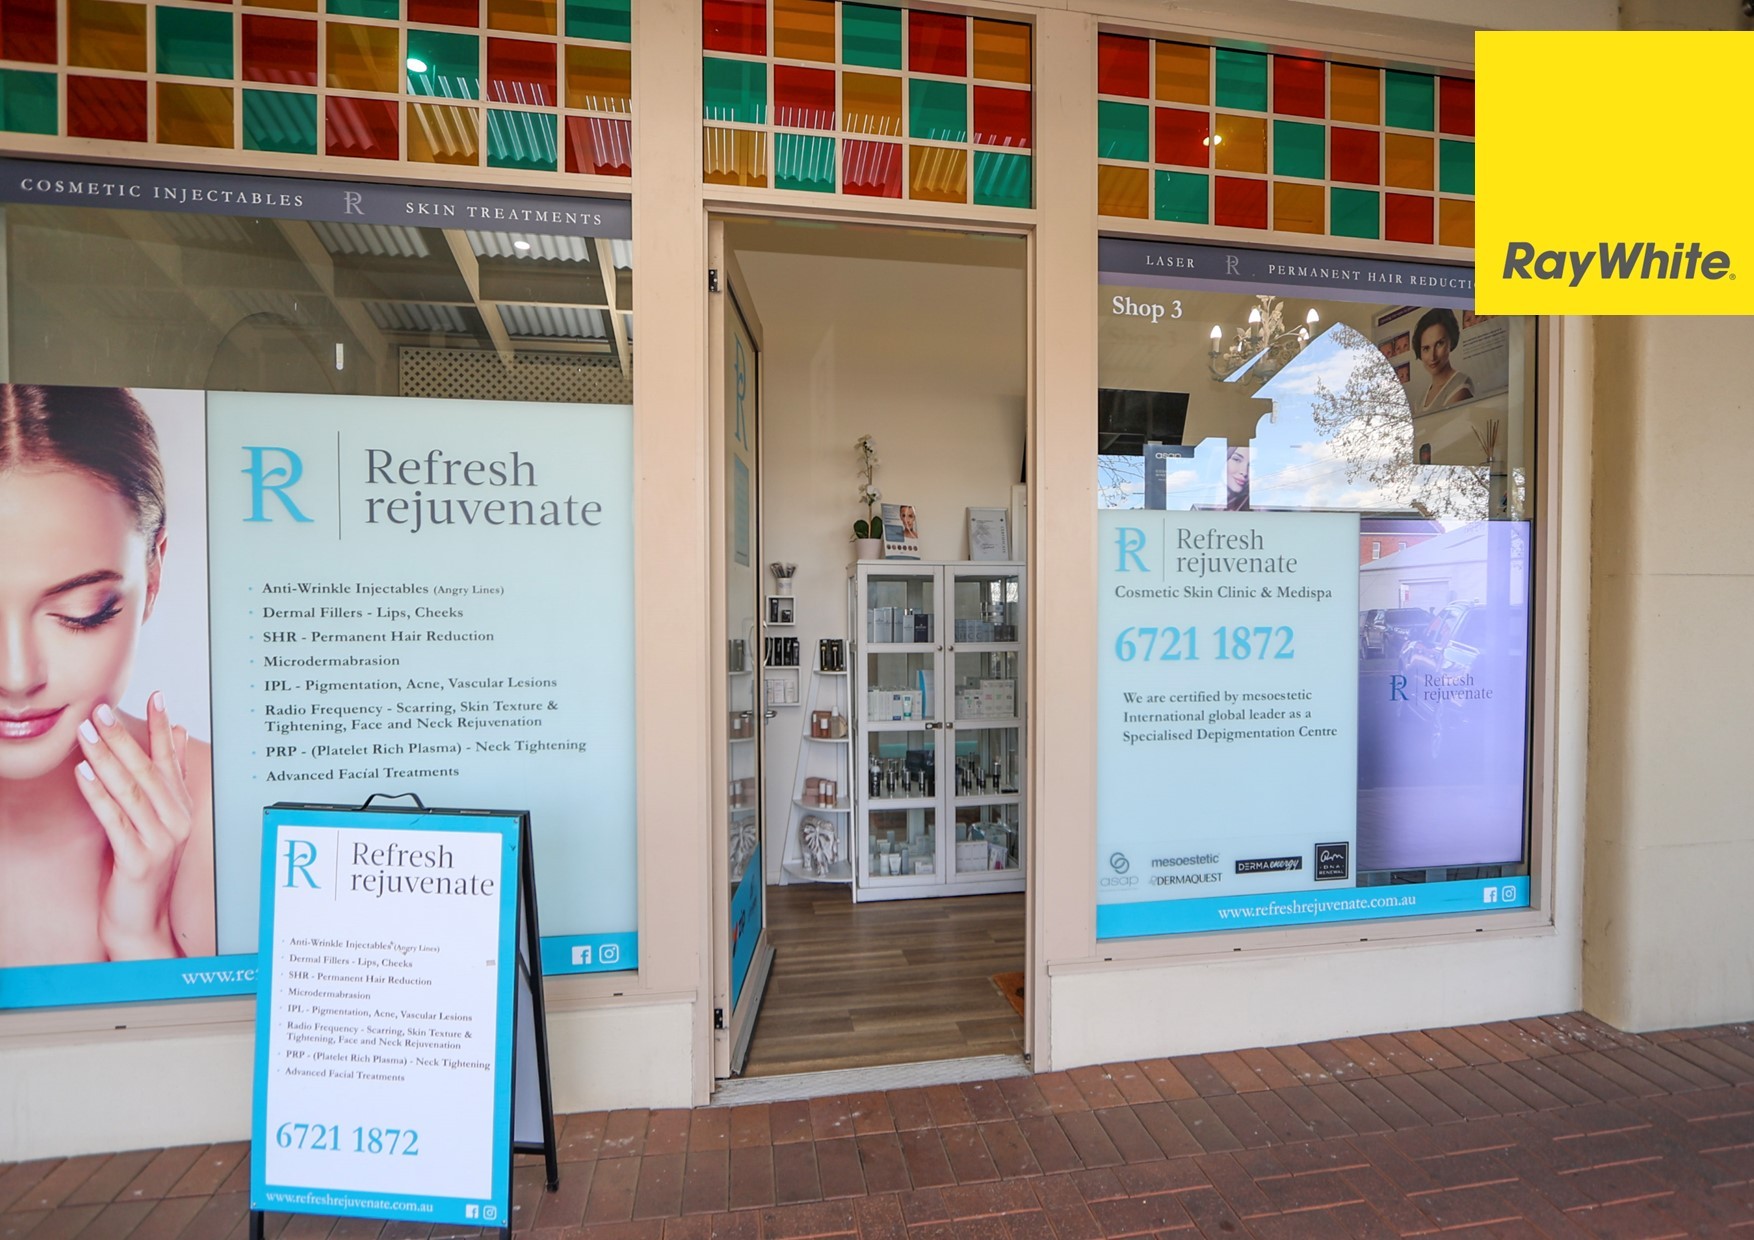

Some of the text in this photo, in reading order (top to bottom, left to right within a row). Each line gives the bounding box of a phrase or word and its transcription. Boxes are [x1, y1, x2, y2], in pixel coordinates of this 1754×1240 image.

[20, 178, 304, 208] COSMETIC INJECTABLES
[405, 202, 603, 226] SKIN TREATMENTS
[1146, 255, 1195, 268] LASER
[1268, 264, 1475, 290] PERMANENT HAIR REDUCTI
[1112, 296, 1183, 323] Shop 3
[364, 448, 539, 487] Refresh
[364, 490, 603, 534] rejuvenate
[1177, 528, 1265, 551] Refresh
[1177, 553, 1298, 577] rejuvenate
[262, 583, 504, 596] Anti-Wrinkle Injectables (Angry Lines)
[1115, 585, 1332, 601] Cosmetic Skin Clinic & Medispa
[263, 607, 315, 618] Dermal
[320, 607, 363, 618] Fillers
[377, 607, 411, 621] Lips,
[415, 607, 464, 618] Cheeks
[263, 631, 297, 643] SHR
[311, 631, 387, 642] Permanent
[391, 631, 422, 642] Hair
[426, 630, 494, 642] Reduction
[1114, 626, 1295, 662] 6721 1872
[264, 655, 400, 667] Microdermabrasion
[264, 681, 292, 691] IPL
[305, 679, 402, 694] Pigmentation,
[406, 679, 444, 691] Acne,
[448, 677, 504, 689] Vascular
[508, 677, 557, 688] Lesions
[1424, 673, 1474, 687] Refresh
[1123, 689, 1312, 705] We are certified by mesoestetic
[1424, 688, 1493, 703] rejuvenate
[265, 705, 306, 716] Radio
[311, 704, 383, 717] Frequency
[396, 702, 456, 715] Scarring,
[460, 701, 489, 712] Skin
[493, 700, 543, 711] Texture
[547, 700, 559, 710] &
[1123, 709, 1312, 724] International global leader as a
[264, 716, 542, 735] Tightening, Face and Neck Rejuvenation
[1123, 726, 1338, 745] Specialised Depigmentation Centre
[266, 746, 297, 757] PRP
[311, 745, 368, 759] (Platelet
[372, 743, 404, 755] Rich
[408, 742, 462, 755] Plasma)
[476, 741, 510, 752] Neck
[514, 740, 587, 754] Tightening
[266, 767, 459, 782] Advanced Facial Treatments
[351, 841, 455, 869] Refresh
[1151, 853, 1219, 868] mesoestetic
[349, 870, 495, 898] rejuvenate
[1100, 876, 1139, 888] asap
[1218, 894, 1416, 921] www.refreshrejuvenate.com.au
[290, 937, 343, 948] Anti-Wrinkle
[346, 940, 391, 950] Injectables
[419, 945, 440, 953] Lines)
[289, 954, 320, 964] Dermal
[323, 956, 349, 965] Fillers
[358, 957, 379, 968] Lips,
[381, 959, 413, 968] Cheeks
[289, 971, 309, 979] SHR
[317, 972, 363, 982] Permanent
[366, 975, 385, 984] Hair
[388, 976, 432, 986] Reduction
[288, 987, 371, 1000] Microdermabrasion
[288, 1004, 304, 1013] IPL
[312, 1005, 371, 1018] Pigmentation,
[374, 1009, 398, 1019] Acne,
[401, 1010, 436, 1020] Vascular
[439, 1012, 473, 1021] Lesions
[287, 1021, 312, 1030] Radio
[314, 1023, 358, 1035] Frequency
[367, 1025, 405, 1037] Scarring,
[407, 1027, 426, 1036] Skin
[429, 1028, 461, 1038] Texture
[287, 1032, 461, 1050] Tightening, Face and Neck Rejuvenation
[286, 1050, 305, 1059] PRP
[313, 1051, 348, 1061] (Platelet
[350, 1054, 370, 1063] Rich
[373, 1055, 407, 1066] Plasma)
[416, 1057, 439, 1067] Neck
[442, 1058, 491, 1071] Tightening
[285, 1067, 405, 1081] Advanced Facial Treatments
[276, 1121, 419, 1156] 6721 1872
[266, 1191, 433, 1213] www.refreshrejuvenate.com.au
